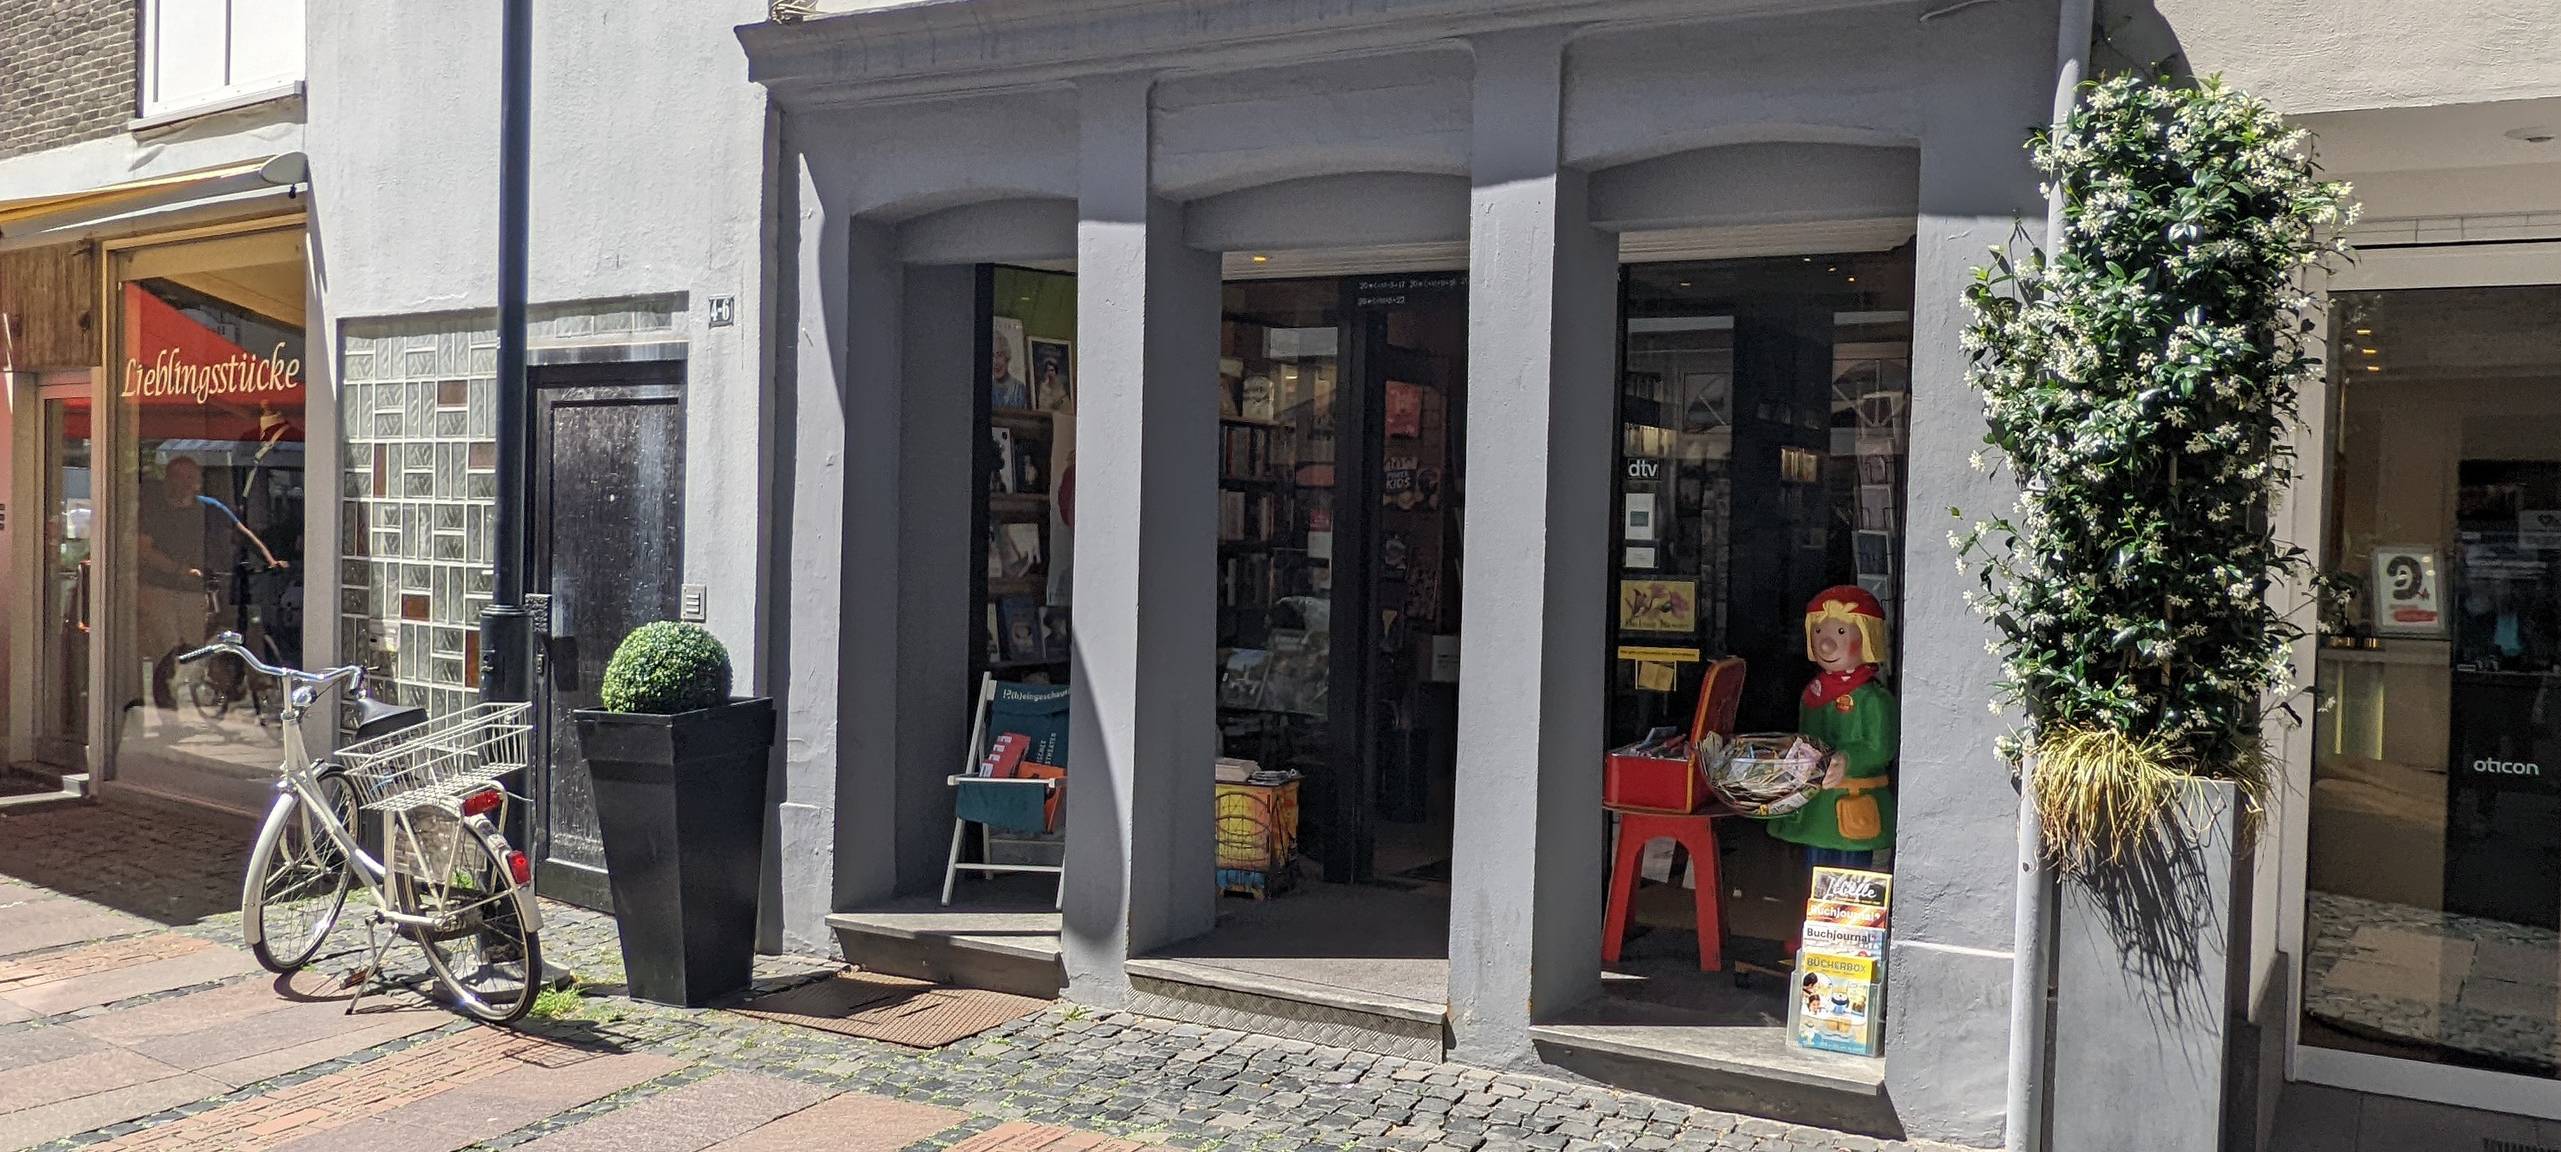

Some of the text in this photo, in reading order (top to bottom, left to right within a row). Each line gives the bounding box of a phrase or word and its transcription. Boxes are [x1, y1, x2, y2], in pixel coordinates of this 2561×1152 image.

[710, 299, 730, 321] 4-6
[120, 342, 300, 404] Lieblingsstücke
[1628, 460, 1658, 477] dtv
[2473, 757, 2540, 776] oticon
[1807, 927, 1871, 943] Buchjournal
